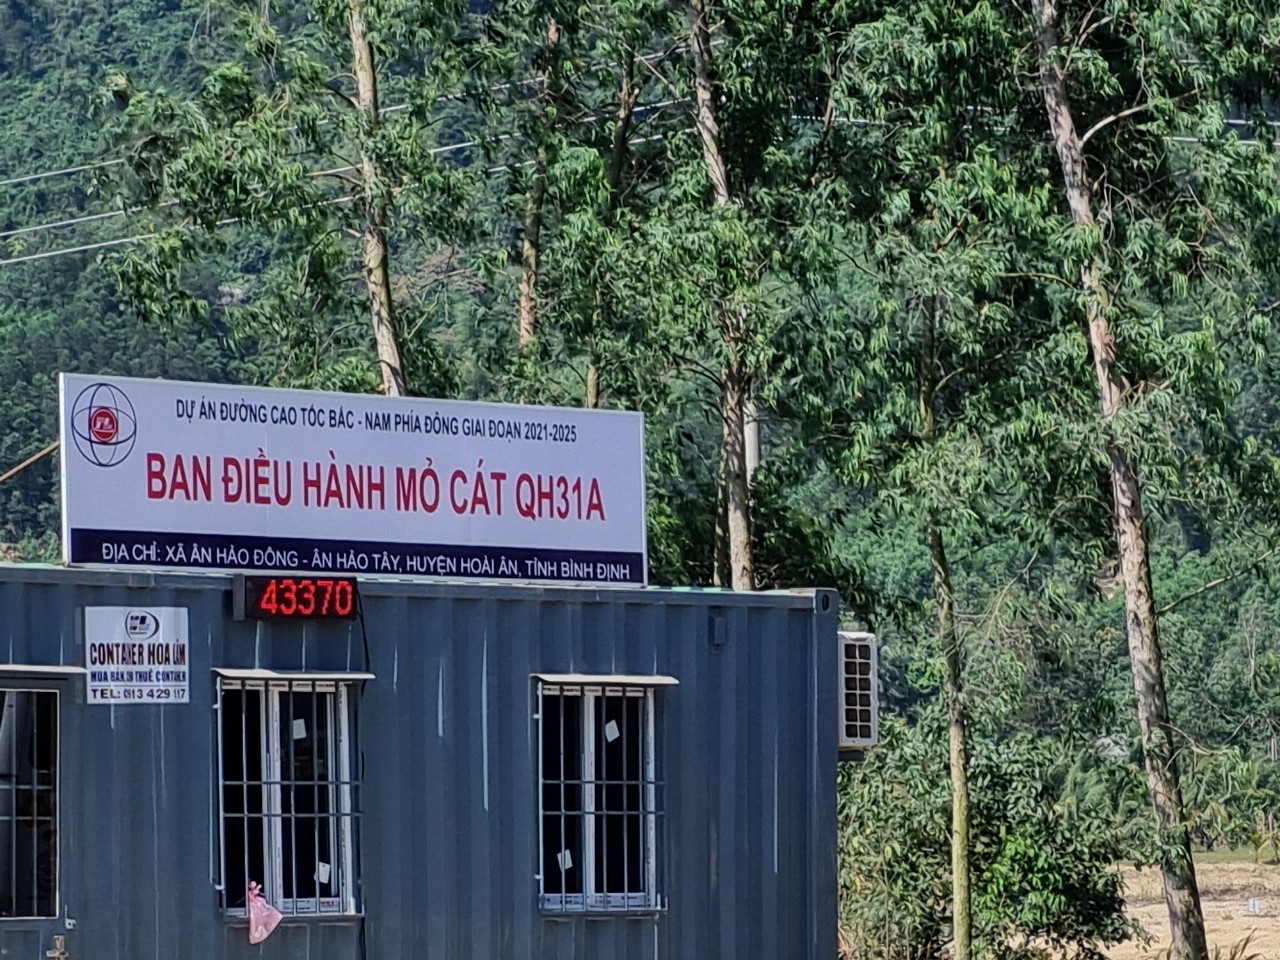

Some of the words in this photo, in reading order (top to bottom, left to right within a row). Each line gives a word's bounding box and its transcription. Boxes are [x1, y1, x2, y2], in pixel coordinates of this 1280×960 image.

[176, 399, 196, 424] DỰ
[199, 396, 217, 420] ÁN
[219, 397, 268, 424] ĐƯỜNG
[270, 405, 298, 426] CAO
[365, 411, 392, 433] NAM
[394, 409, 422, 434] PHÍA
[424, 412, 459, 436] ĐÔNG
[462, 417, 486, 438] GIAI
[488, 419, 522, 443] ĐOẠN
[523, 422, 578, 443] 2021-2025
[146, 452, 212, 502] BAN
[221, 447, 292, 507] ĐIỀU
[302, 449, 386, 511] HÀNH
[395, 456, 441, 514] MỎ
[449, 458, 507, 517] CÁT
[515, 472, 606, 522] QH31A
[101, 542, 130, 563] ĐỊA
[132, 540, 161, 562] CHỈ:
[165, 542, 187, 563] XÃ
[190, 542, 212, 564] ÂN
[216, 543, 250, 565] HẢO
[253, 545, 299, 568] ĐÔNG
[311, 548, 333, 569] ÂN
[336, 549, 369, 570] HẢO
[371, 550, 402, 573] TÂY,
[406, 554, 457, 576] HUYỆN
[460, 554, 495, 575] HOÀI
[498, 555, 522, 578] ÂN,
[524, 556, 557, 577] TỈNH
[561, 557, 594, 579] BÌNH
[596, 562, 630, 581] ĐỊNH
[261, 579, 353, 615] 43370
[147, 642, 171, 666] HOA
[90, 670, 109, 683] MUA
[90, 688, 121, 700] TEL:
[146, 688, 171, 700] 429
